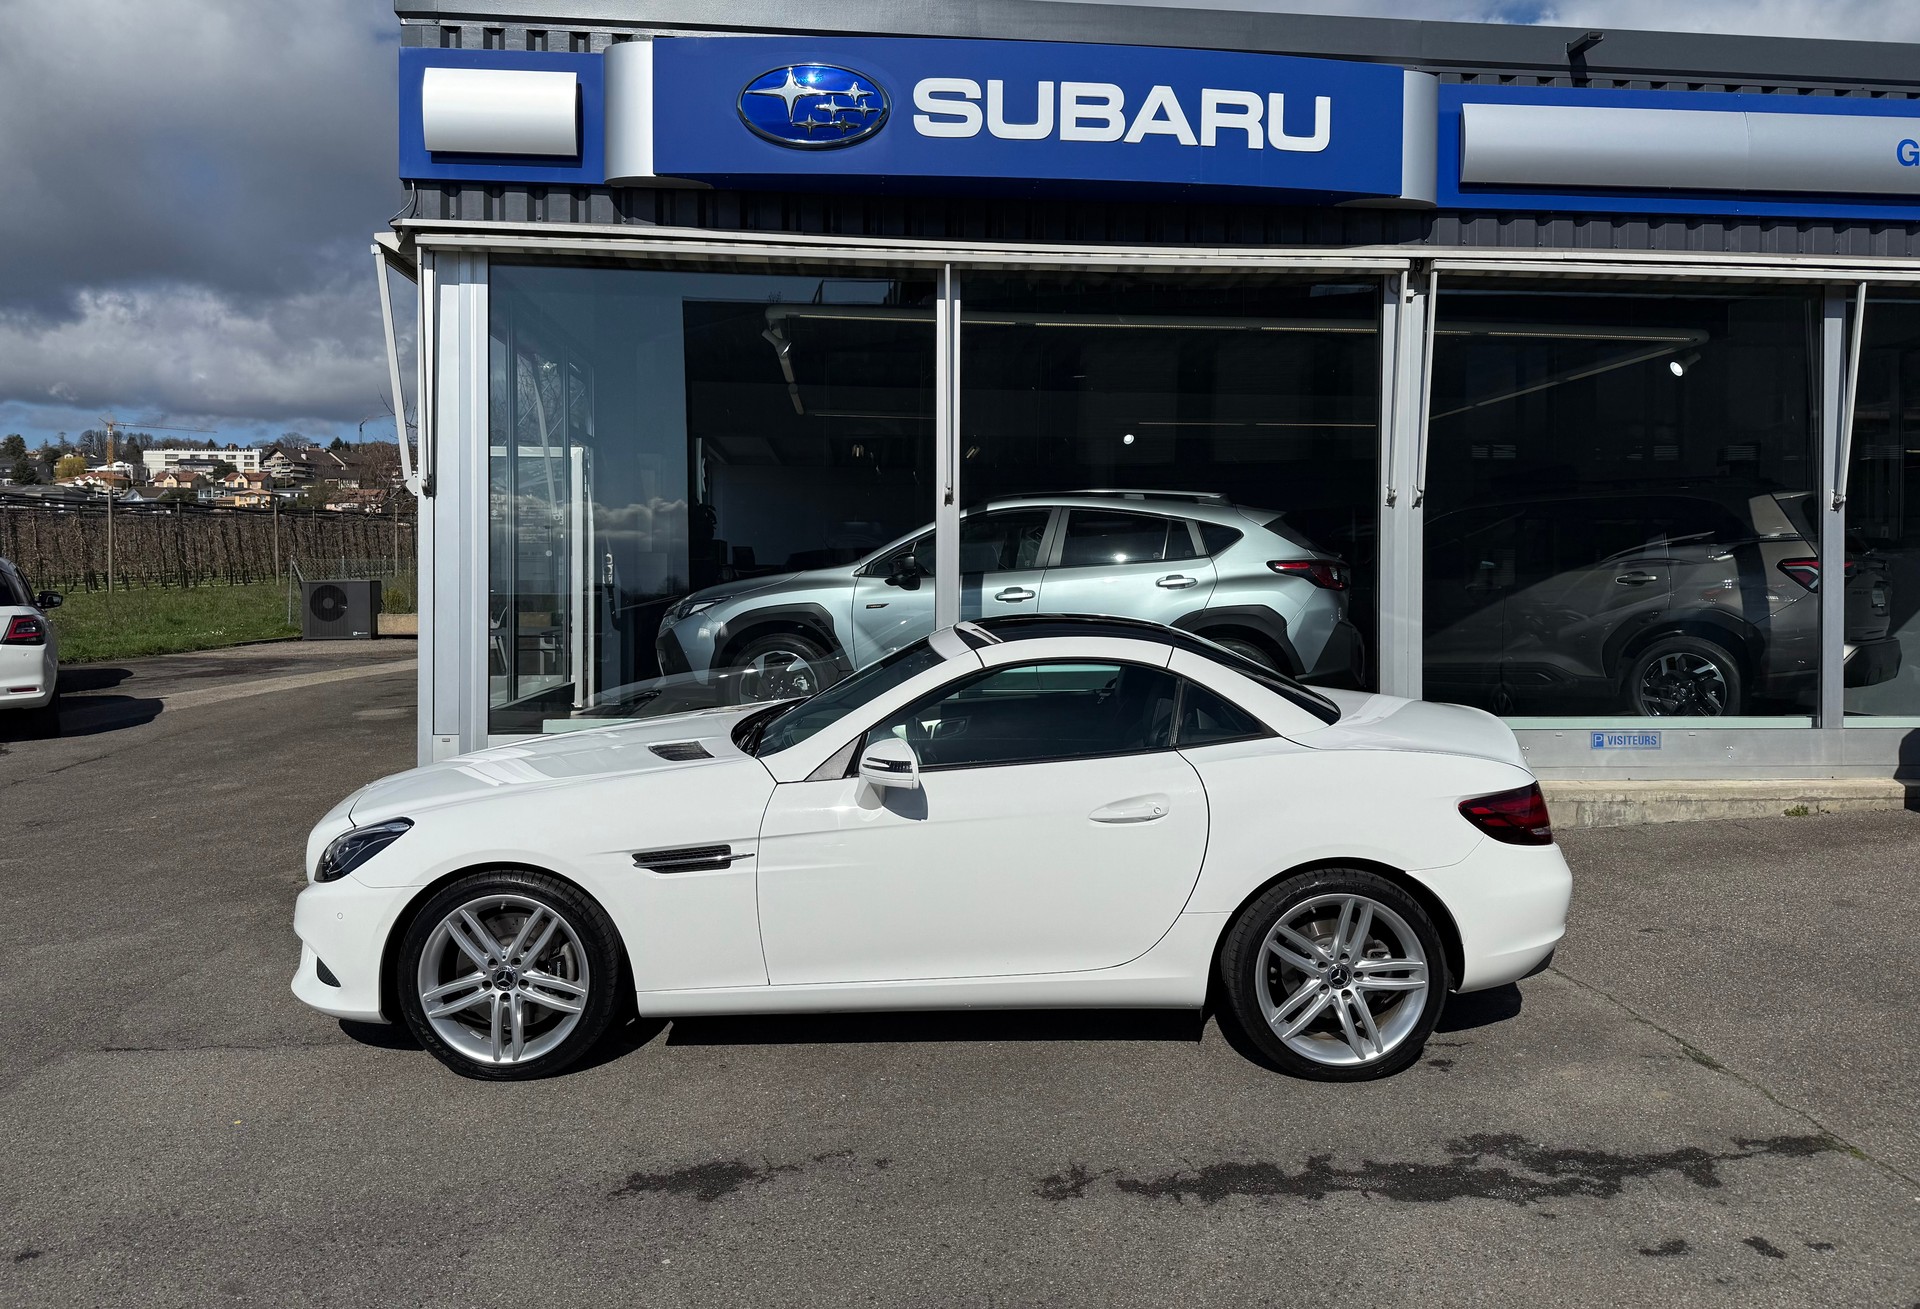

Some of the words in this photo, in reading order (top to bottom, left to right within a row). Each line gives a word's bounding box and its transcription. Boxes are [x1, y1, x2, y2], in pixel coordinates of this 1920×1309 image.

[912, 77, 1331, 152] SUBARU
[1594, 734, 1602, 747] P
[1607, 735, 1657, 746] VISITEURS
